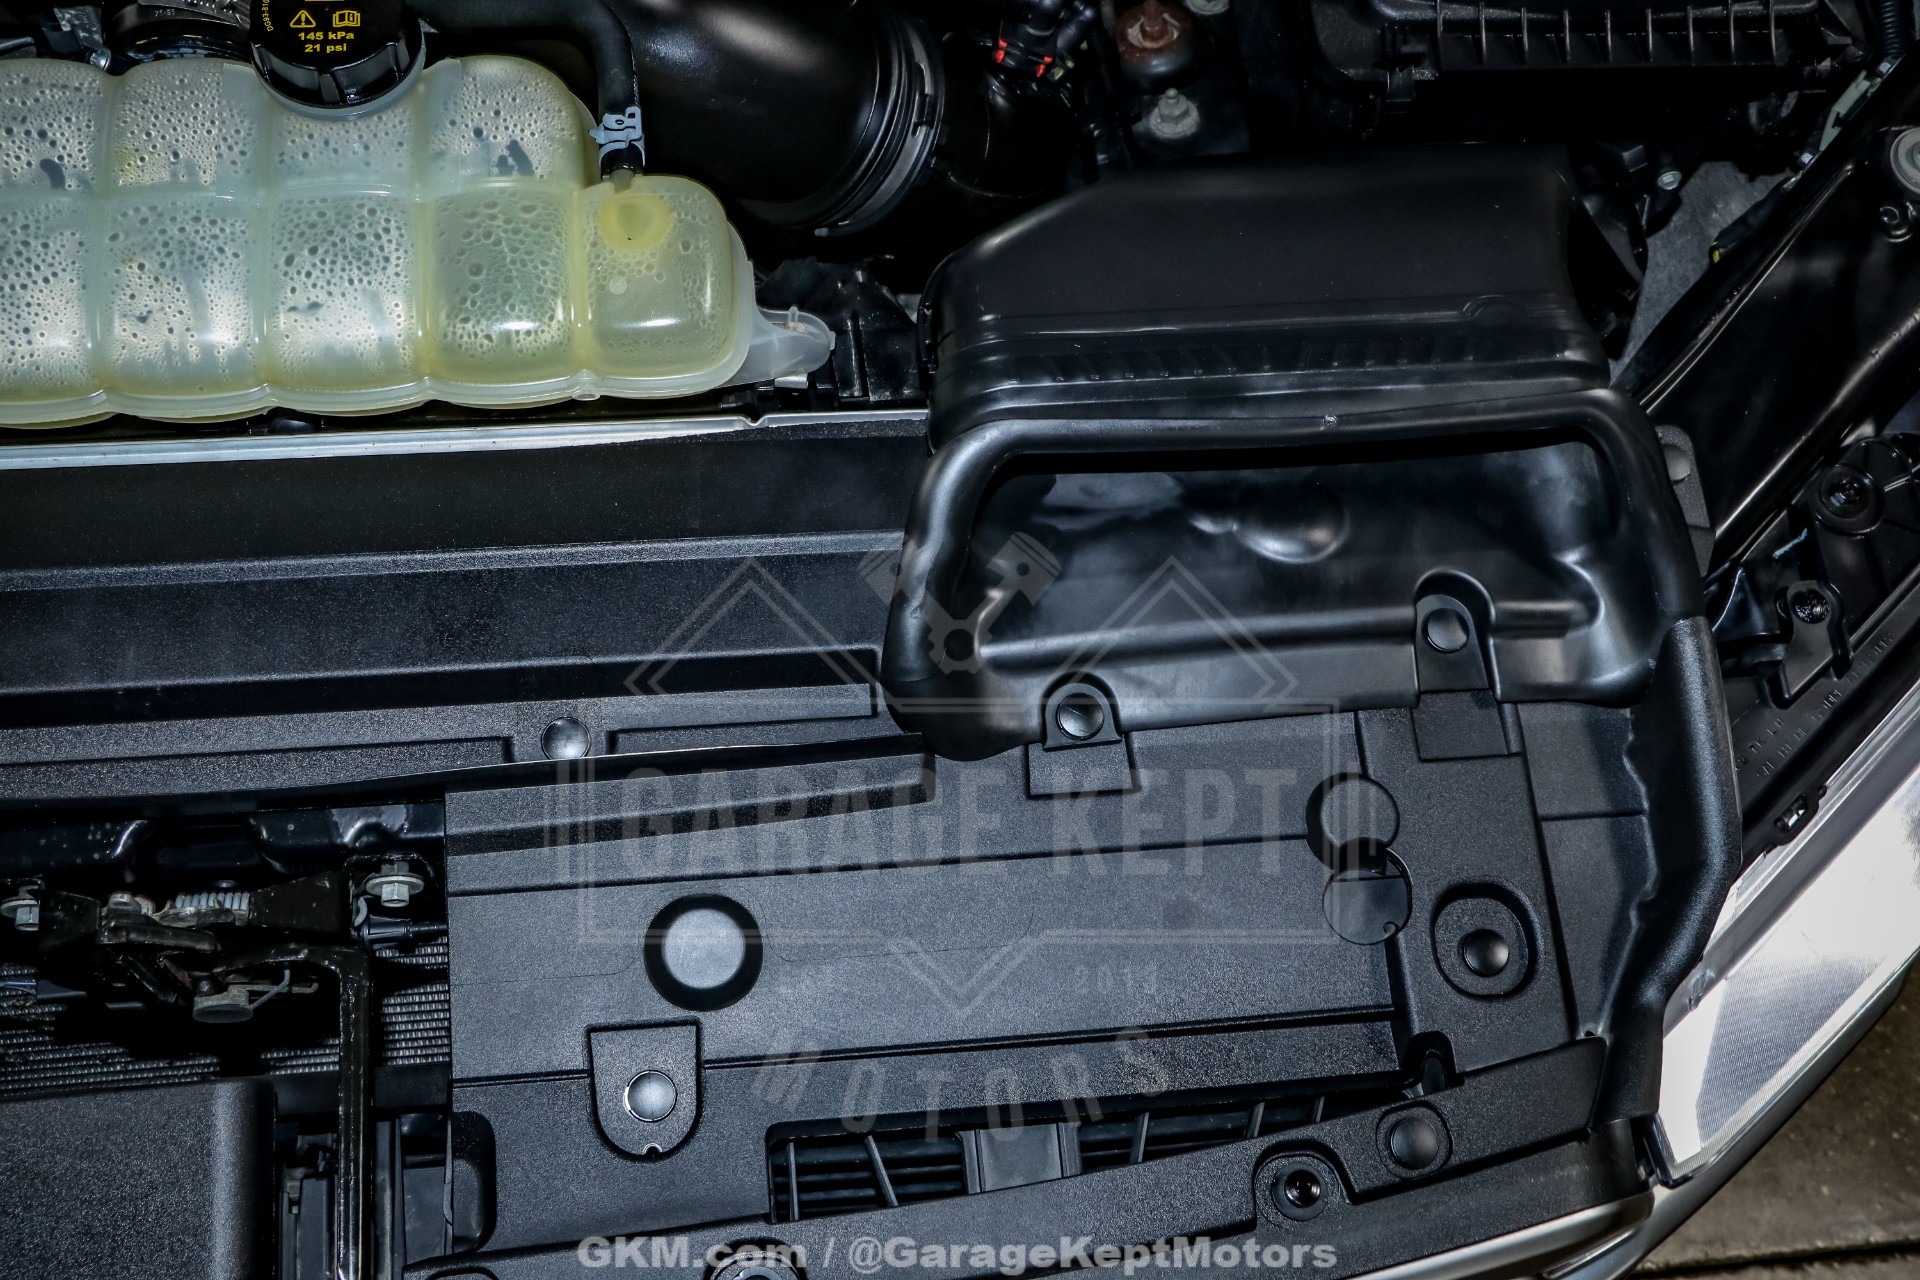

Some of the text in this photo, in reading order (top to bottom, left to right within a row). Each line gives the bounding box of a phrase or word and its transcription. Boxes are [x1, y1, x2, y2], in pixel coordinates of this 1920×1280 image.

[298, 31, 355, 40] 145 kPa
[304, 43, 347, 54] 21 psi
